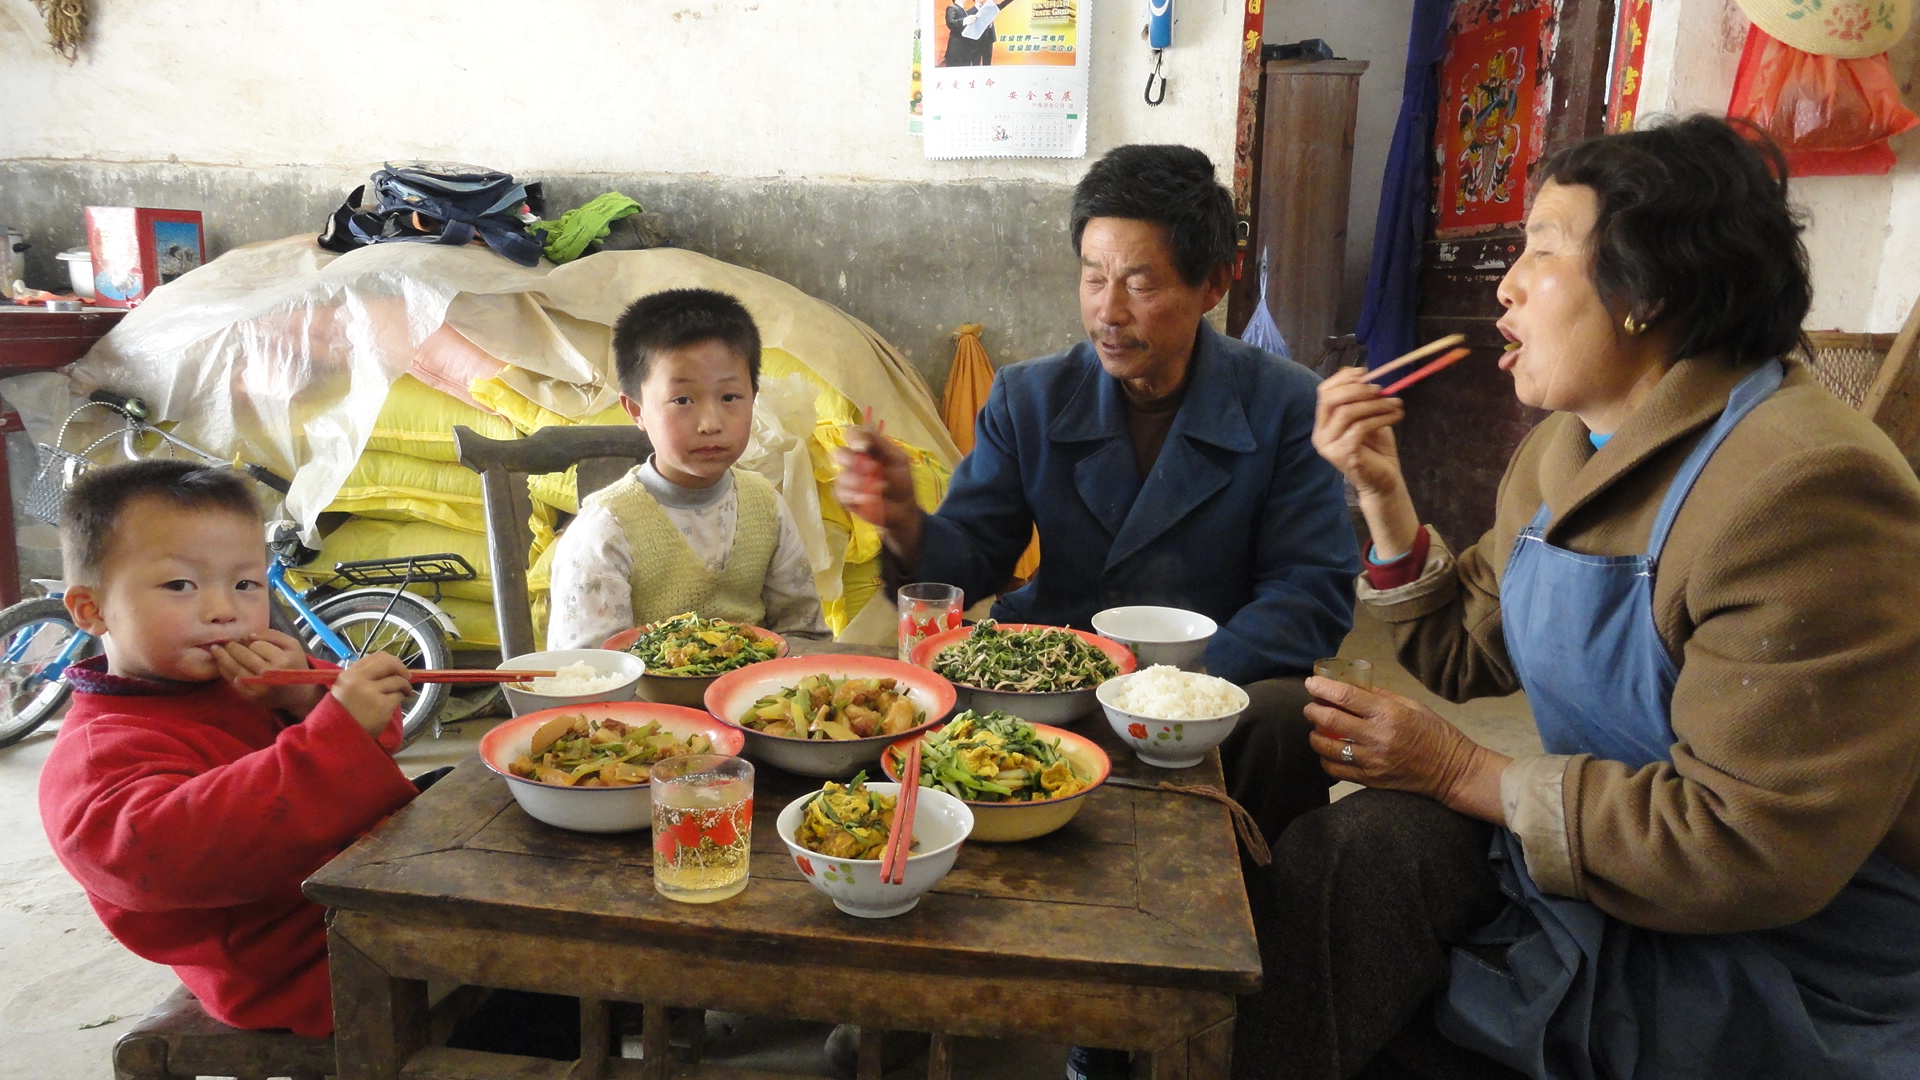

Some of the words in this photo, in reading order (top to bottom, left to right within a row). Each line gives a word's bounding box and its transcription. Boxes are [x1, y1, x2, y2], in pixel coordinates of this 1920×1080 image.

[1051, 7, 1070, 16] GRID
[1000, 34, 1065, 42] 建设世界一流电网
[1008, 44, 1073, 52] 建设国际一流企业
[935, 77, 996, 90] 关爱生命
[1008, 90, 1072, 101] 安全发展
